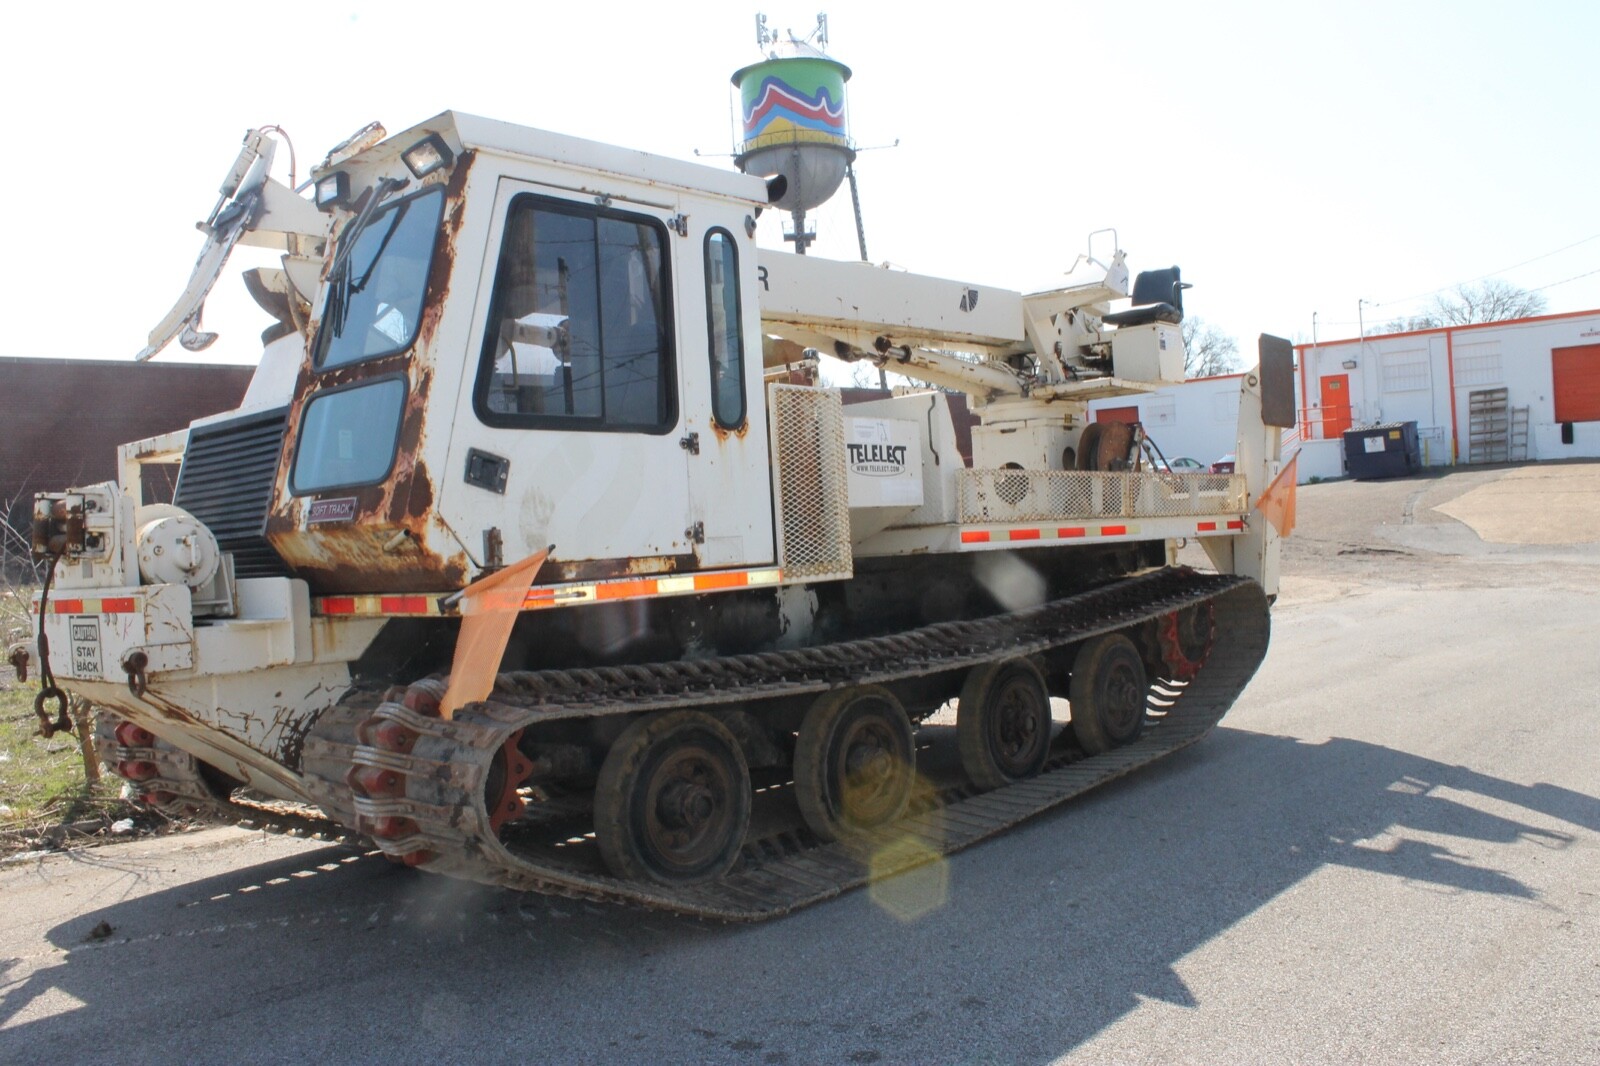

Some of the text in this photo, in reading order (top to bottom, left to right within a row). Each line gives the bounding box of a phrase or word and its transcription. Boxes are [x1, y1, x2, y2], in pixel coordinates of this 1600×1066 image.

[847, 444, 907, 465] TELELECT
[311, 503, 351, 517] SOFT TRACK
[76, 646, 96, 657] STAY
[76, 661, 99, 673] BACK
